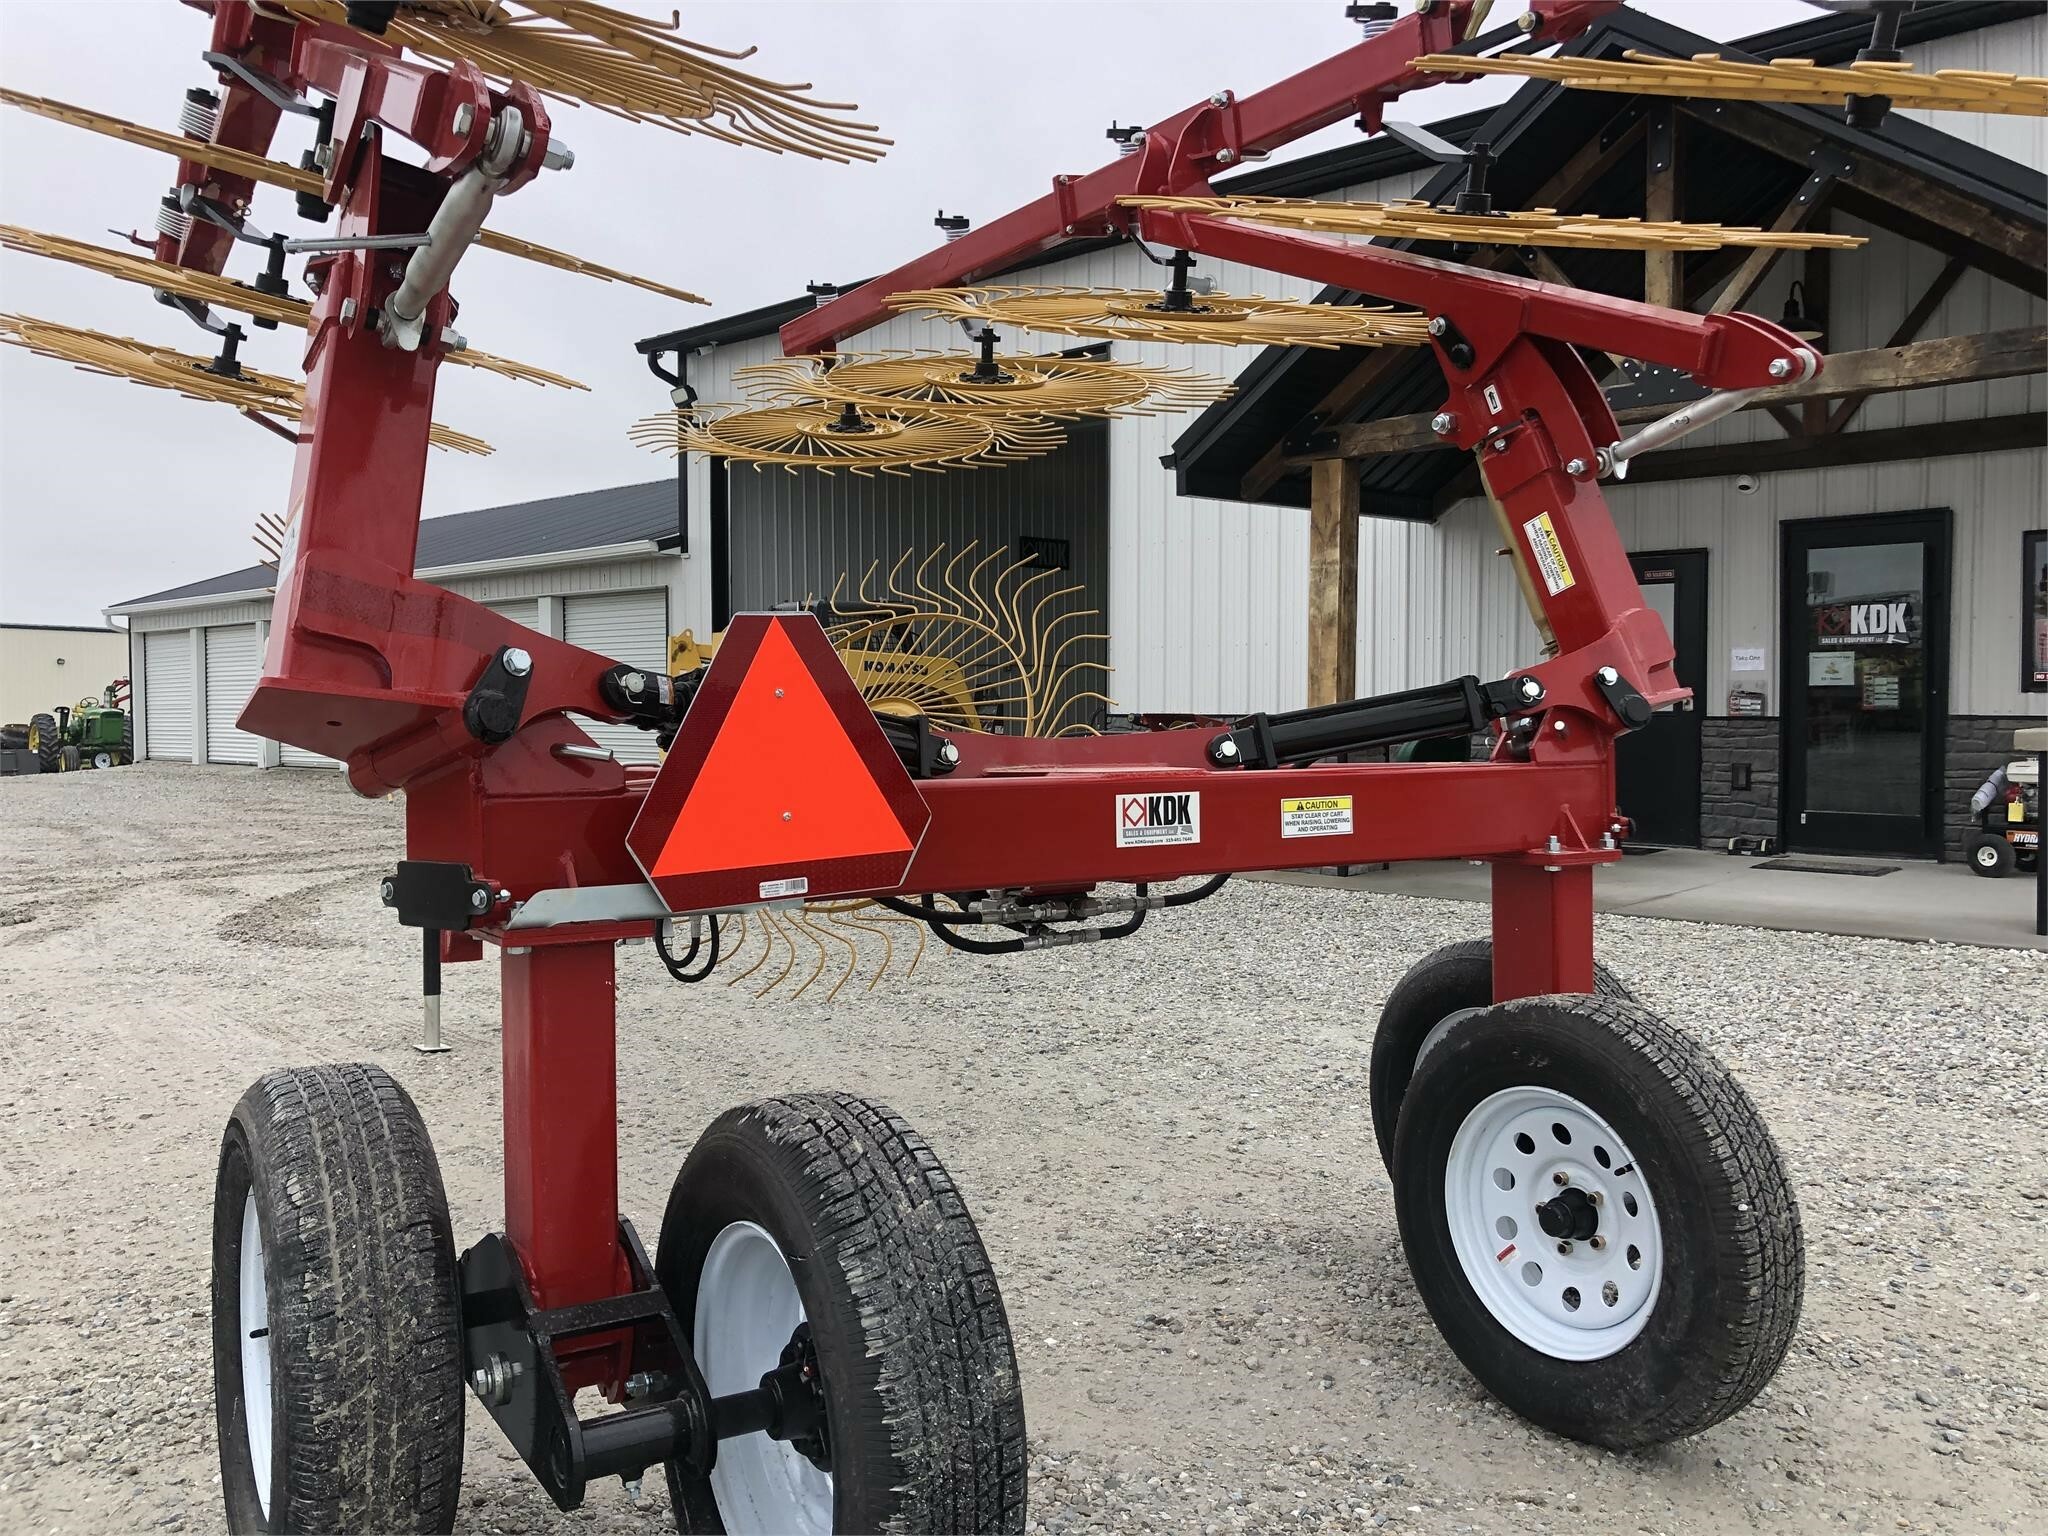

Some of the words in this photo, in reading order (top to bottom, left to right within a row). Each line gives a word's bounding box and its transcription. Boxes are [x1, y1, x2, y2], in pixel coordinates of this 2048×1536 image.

[1550, 537, 1567, 573] CAUTION
[1850, 603, 1907, 634] KDK
[1148, 795, 1192, 826] KDK
[1305, 800, 1338, 810] CAUTION
[1323, 817, 1350, 825] LOWERING
